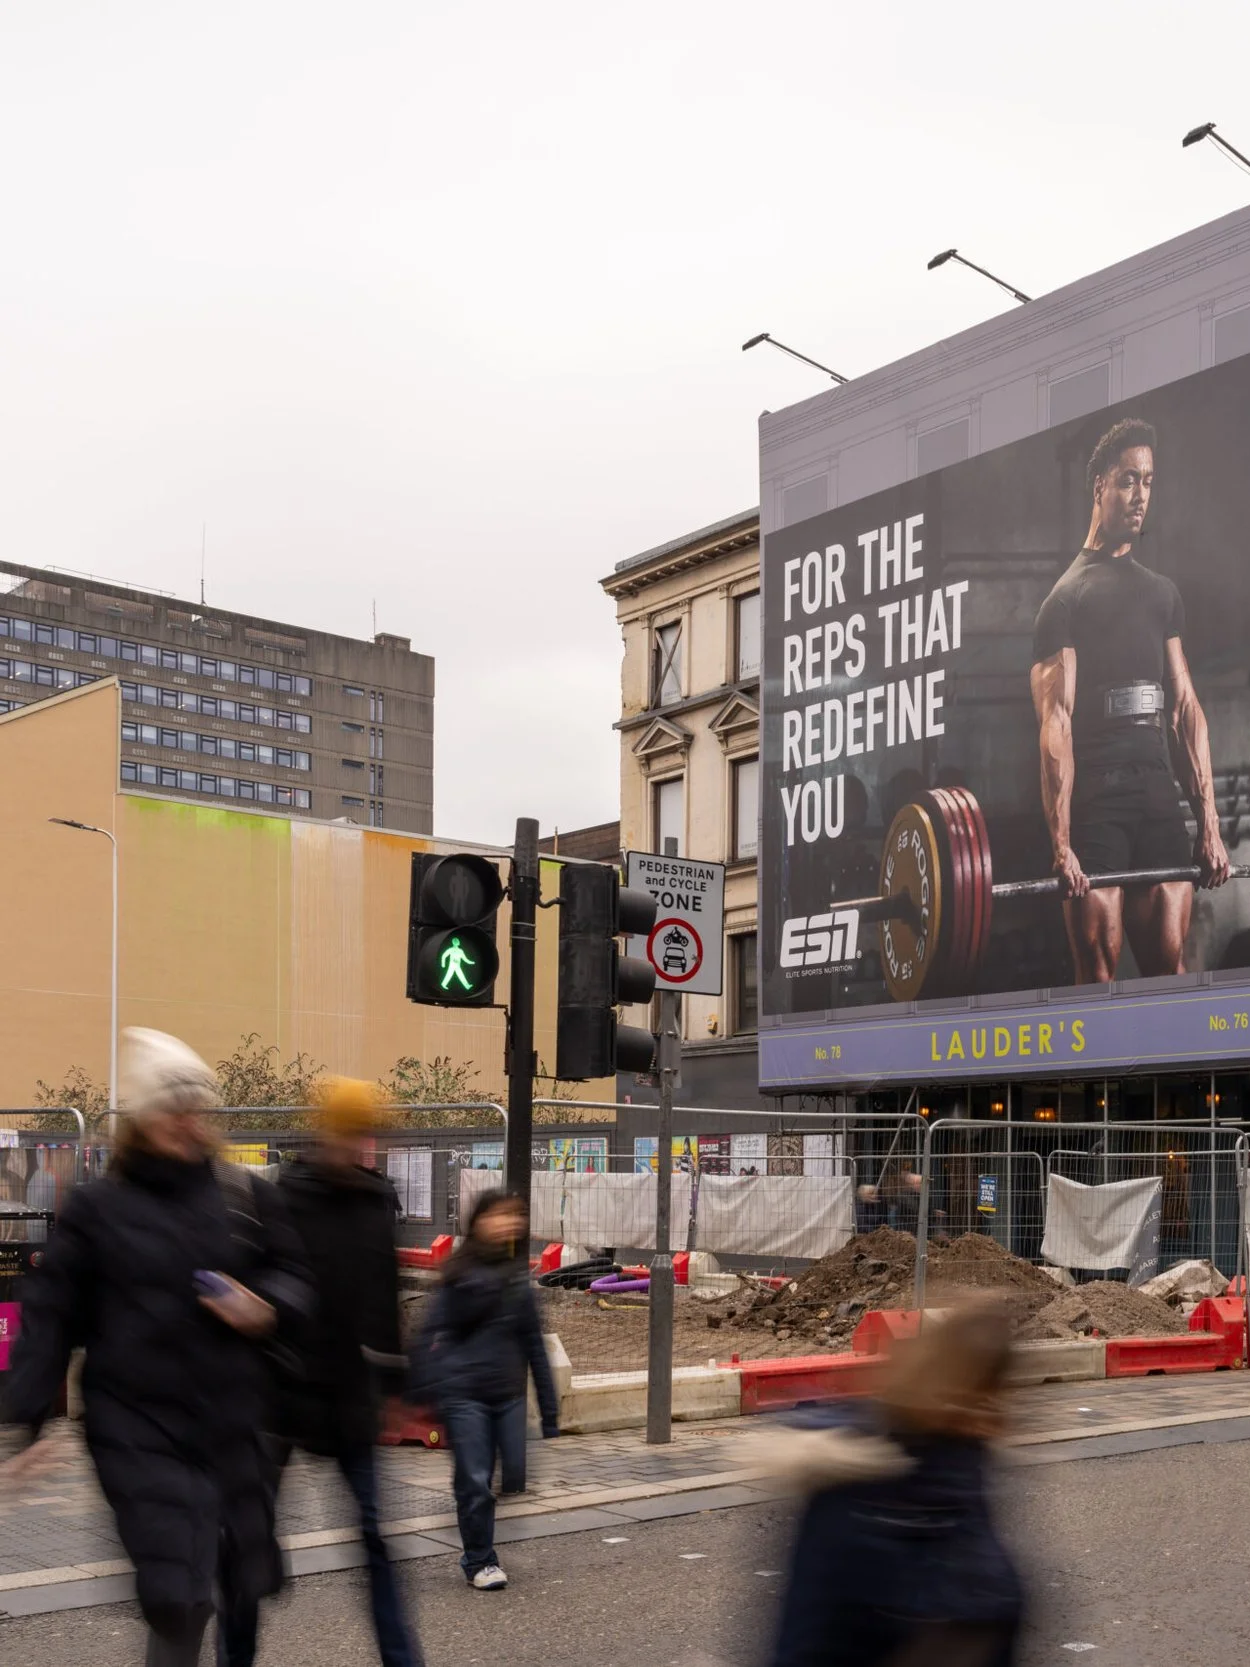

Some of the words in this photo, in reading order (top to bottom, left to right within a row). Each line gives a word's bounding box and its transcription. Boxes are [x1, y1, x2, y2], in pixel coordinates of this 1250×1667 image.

[784, 543, 846, 622] FOR
[858, 513, 924, 596] THE
[783, 613, 866, 697] REPS
[878, 580, 969, 668] THAT
[783, 669, 945, 772] REDEFINE
[780, 774, 845, 847] YOU
[639, 860, 714, 881] PEDESTRIAN
[645, 876, 665, 887] and
[669, 878, 707, 892] CYCLE
[785, 971, 800, 979] ELITE
[801, 968, 823, 977] SPORTS
[824, 964, 853, 973] NUTRITION
[1209, 1015, 1230, 1031] No.
[1234, 1012, 1249, 1029] 76
[815, 1047, 829, 1060] No.
[831, 1045, 841, 1059] 78
[931, 1020, 1086, 1061] LAUDER'S
